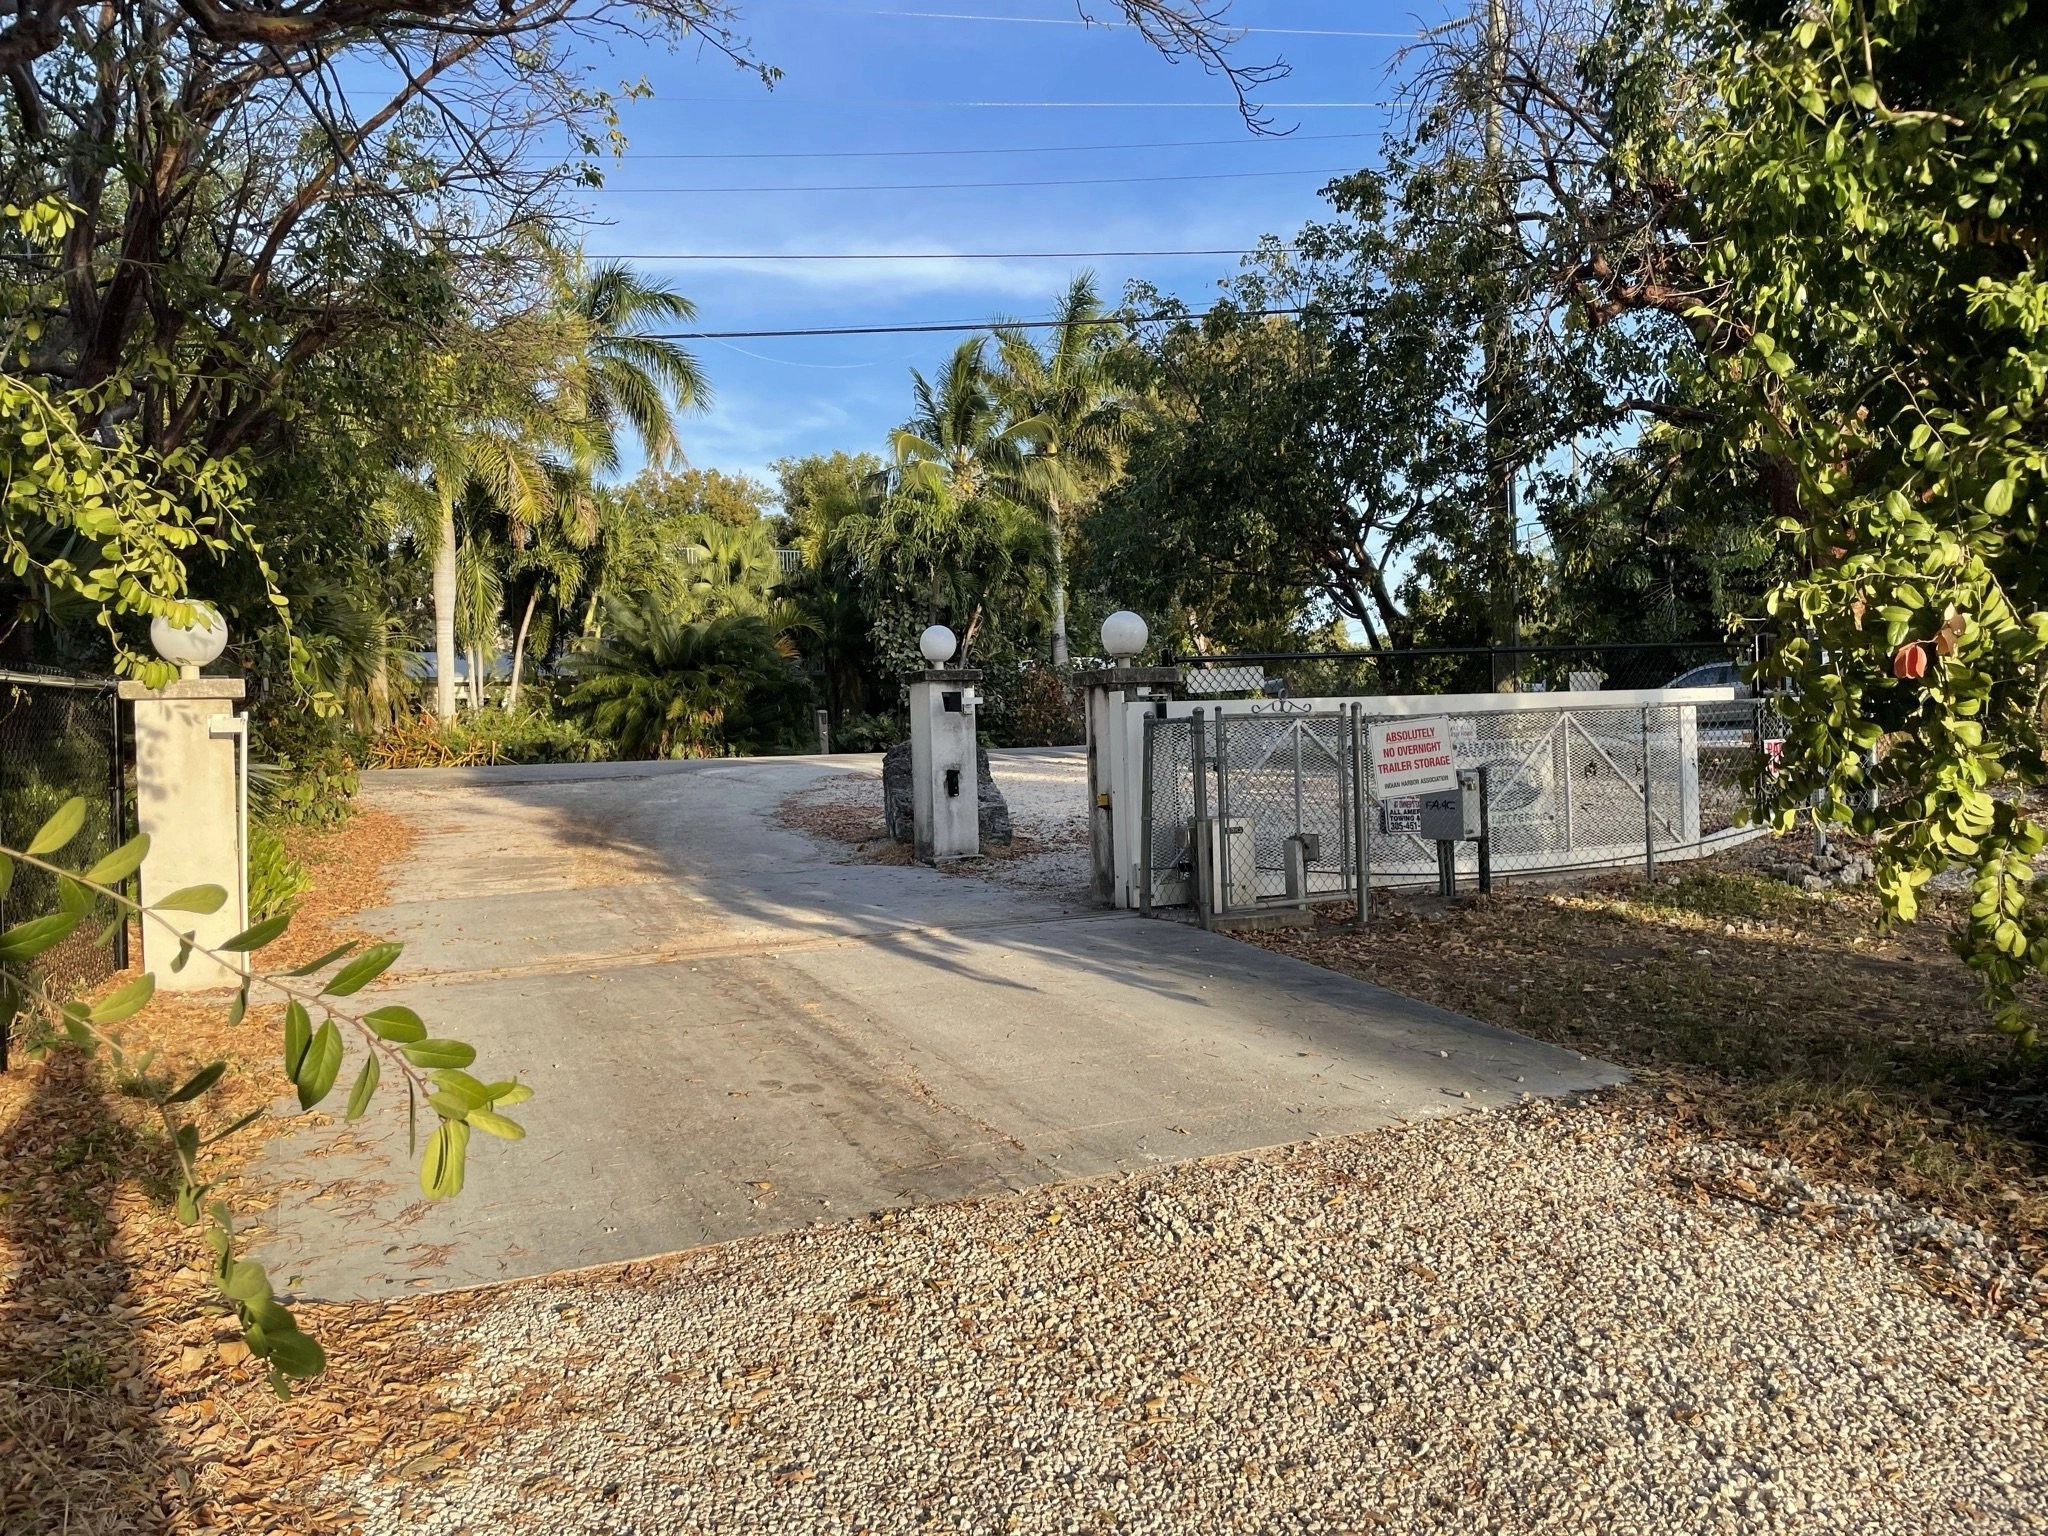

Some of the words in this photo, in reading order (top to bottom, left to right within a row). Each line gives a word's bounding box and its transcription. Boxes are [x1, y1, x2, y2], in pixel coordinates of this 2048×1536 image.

[1385, 727, 1435, 742] ABSOLUTELY
[1383, 747, 1395, 758] NO
[1397, 742, 1441, 756] OVERNIGHT
[1377, 760, 1412, 774] TRAILER
[1414, 755, 1451, 769] STORAGE
[1401, 778, 1420, 787] HARBOR
[1420, 775, 1449, 784] ASSOCIATION
